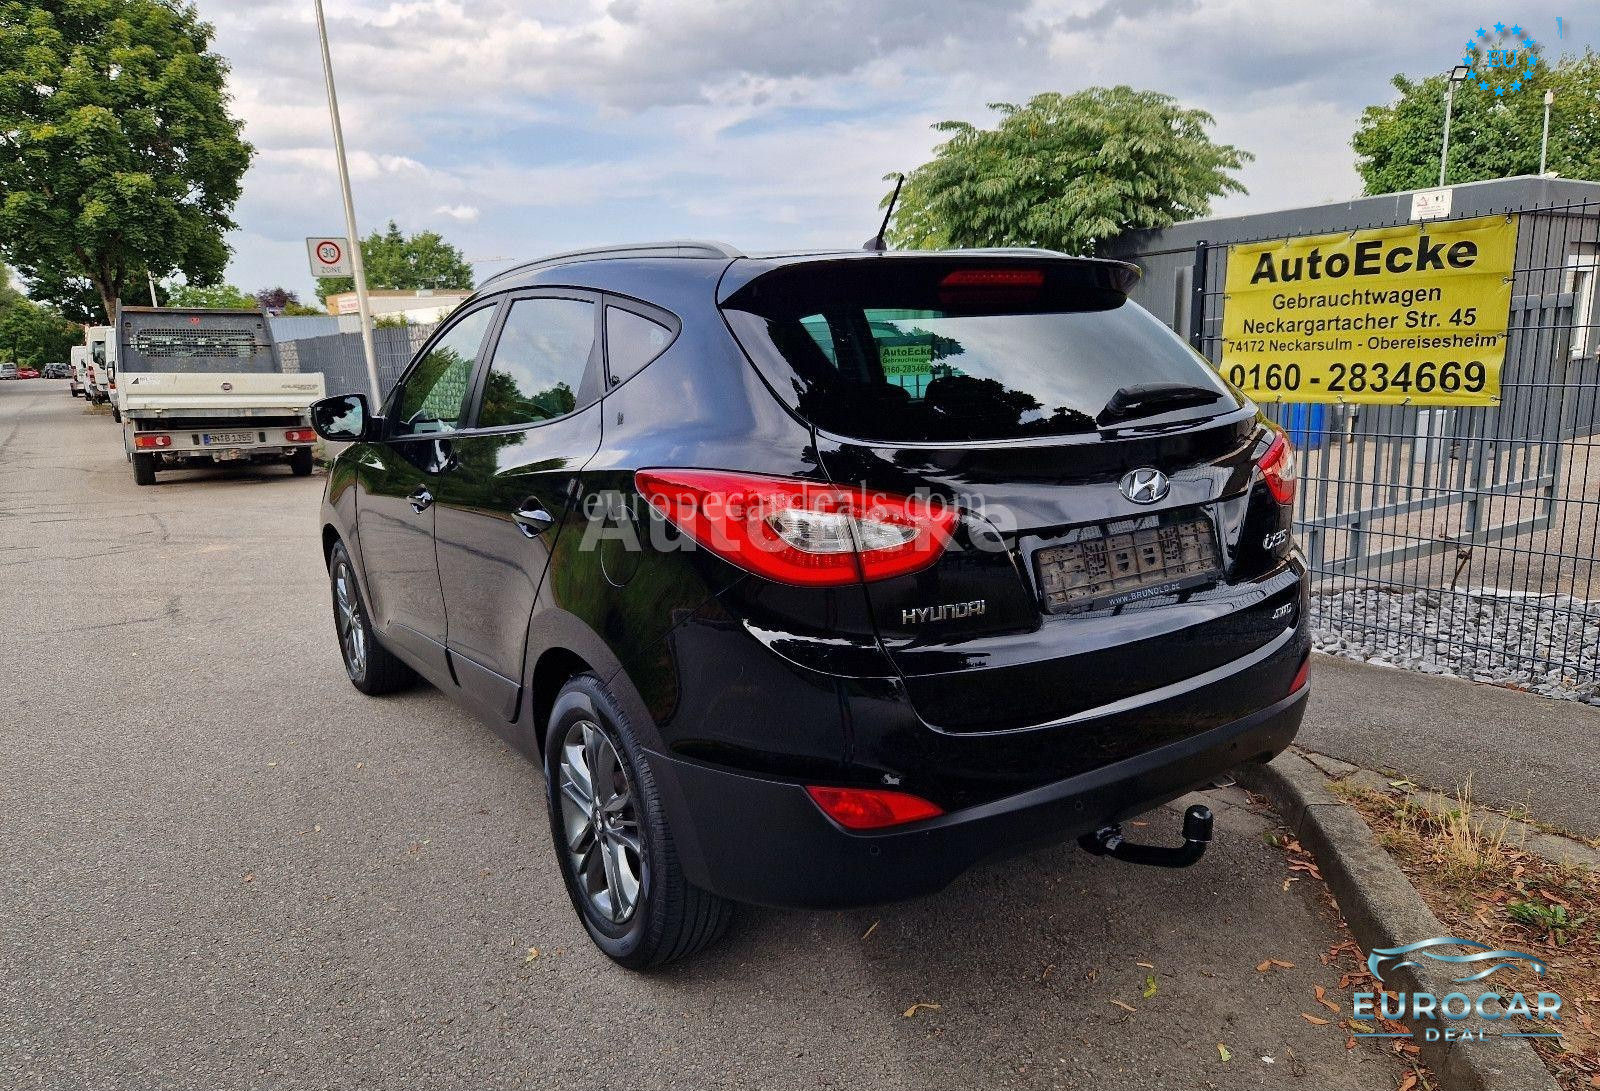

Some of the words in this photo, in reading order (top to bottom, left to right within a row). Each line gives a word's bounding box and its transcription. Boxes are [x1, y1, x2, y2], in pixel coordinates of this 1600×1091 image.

[322, 247, 336, 258] 30
[1250, 235, 1478, 285] AutoEcke
[321, 266, 342, 274] ZONE
[1272, 287, 1442, 310] Gebrauchtwagen
[1243, 313, 1399, 336] Neckargartacher
[1405, 310, 1441, 328] Str.
[1449, 307, 1477, 327] 45
[1228, 340, 1265, 353] 74172
[1269, 338, 1352, 352] Neckarsulm
[1367, 333, 1497, 350] Obereisesheim
[1229, 363, 1301, 391] 0160
[1327, 361, 1486, 393] 2834669
[902, 599, 986, 625] HYUNDAI
